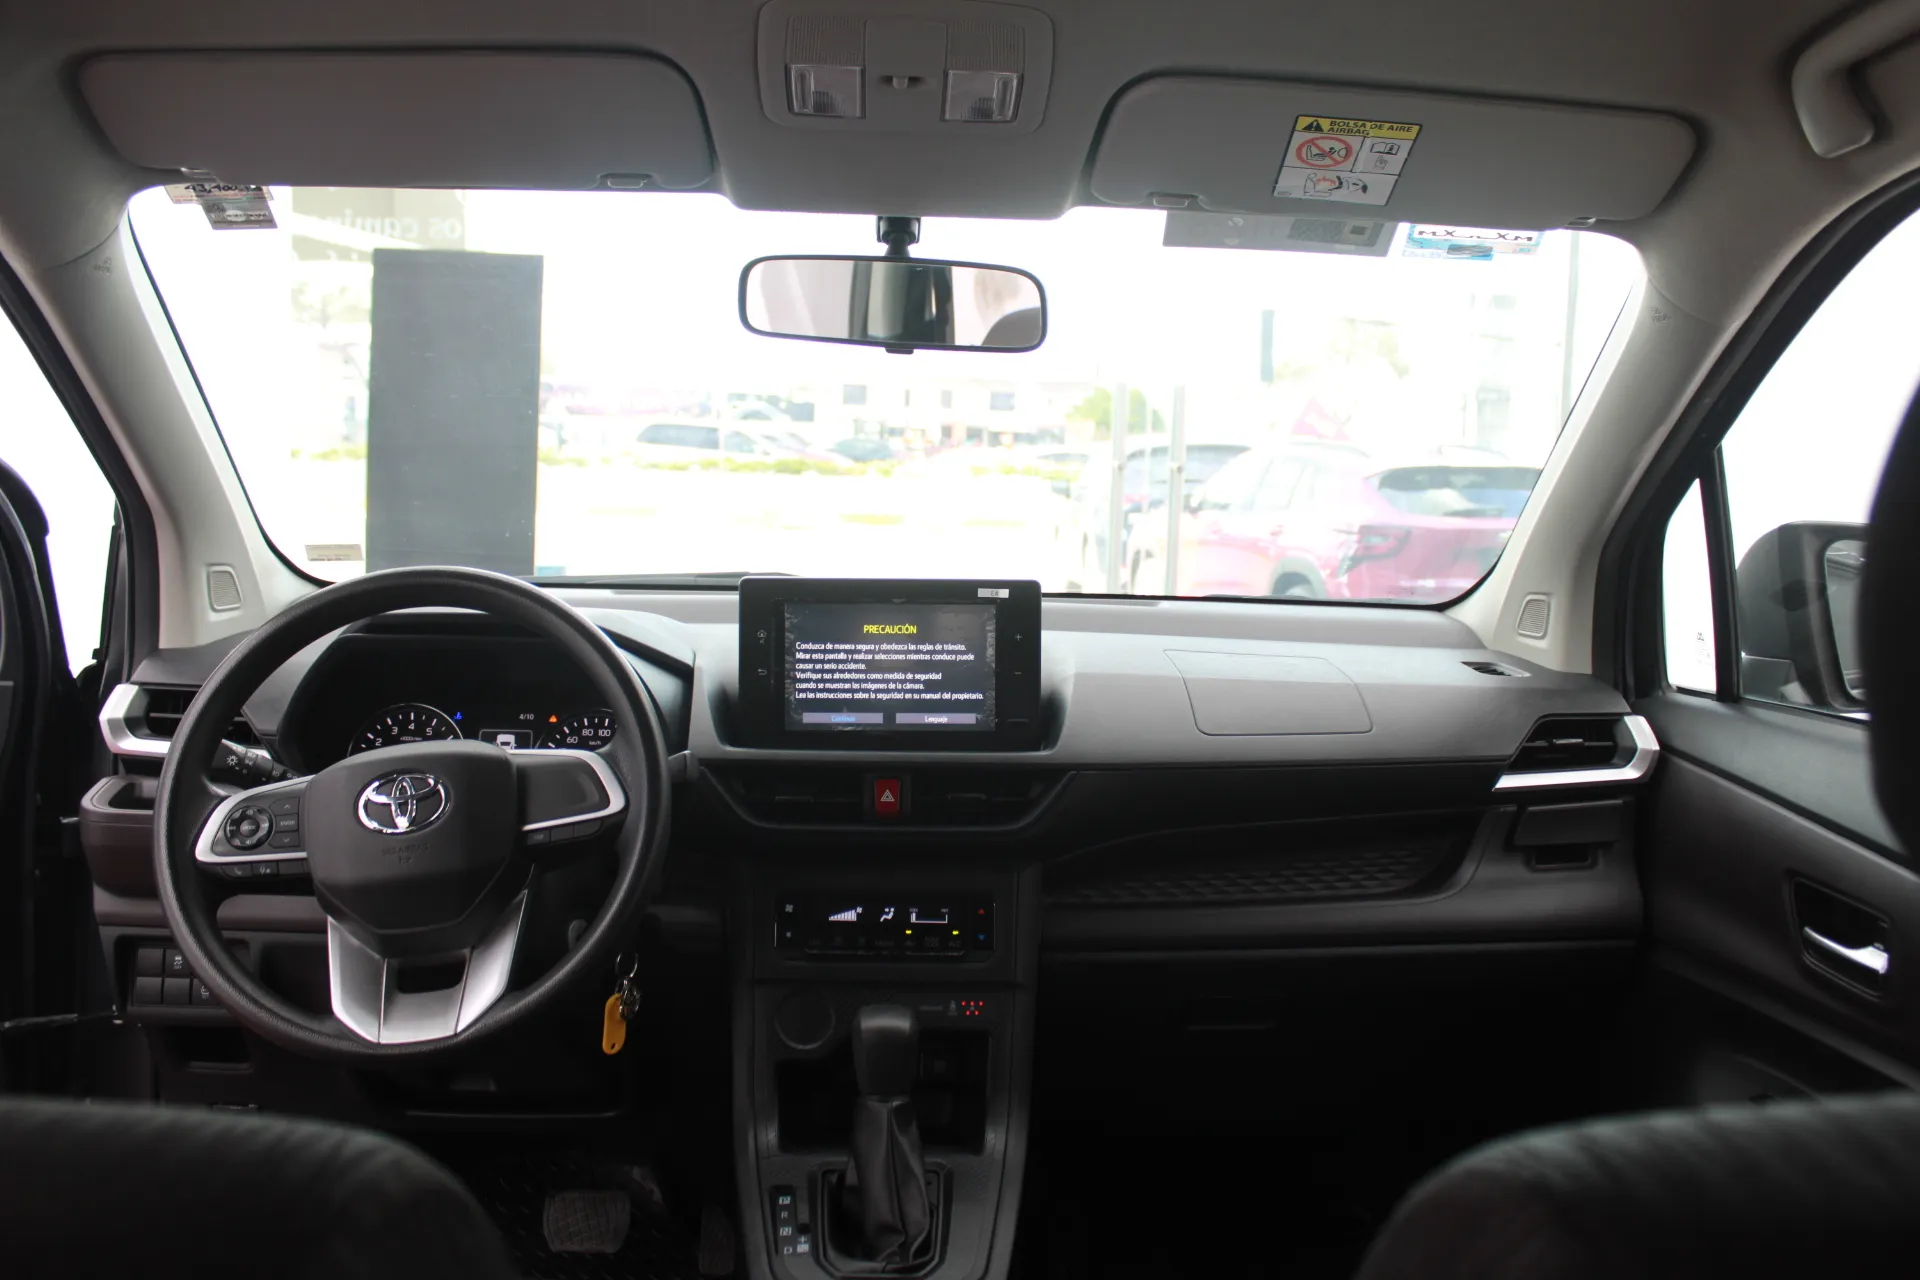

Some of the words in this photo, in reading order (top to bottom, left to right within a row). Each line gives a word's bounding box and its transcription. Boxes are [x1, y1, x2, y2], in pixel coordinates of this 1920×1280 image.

[1327, 126, 1370, 136] AIRBAG
[1329, 120, 1367, 129] BOLSA
[1369, 122, 1385, 131] DE
[1387, 124, 1413, 133] AIRE
[863, 623, 917, 634] PRECAUCIÓN
[795, 642, 825, 650] Conduzca
[825, 642, 833, 650] de
[880, 643, 908, 651] obedezca
[908, 643, 916, 651] las
[917, 643, 934, 652] reglas
[934, 643, 942, 651] de
[943, 643, 967, 651] tránsito.
[795, 652, 811, 660] Mirar
[824, 652, 847, 661] pantalla
[852, 652, 873, 660] realizar
[874, 652, 905, 660] selecciones
[931, 653, 956, 661] conduce
[956, 653, 975, 662] puede
[823, 662, 837, 670] serio
[837, 662, 867, 670] accidente.
[796, 672, 822, 680] Verifique
[884, 672, 905, 680] medida
[905, 672, 914, 680] de
[914, 672, 942, 681] seguridad
[860, 682, 887, 690] imágenes
[902, 682, 925, 690] cámara.
[795, 691, 806, 699] Lea
[806, 691, 815, 699] las
[815, 691, 852, 699] instrucciones
[853, 691, 869, 699] sobre
[870, 691, 875, 699] la
[876, 692, 904, 701] seguridad
[951, 692, 984, 700] propietario.
[924, 715, 948, 723] Lenguaje
[391, 726, 398, 735] 3
[408, 722, 415, 730] 4
[426, 727, 433, 736] 5
[581, 728, 594, 736] 80
[598, 729, 611, 737] 100
[375, 738, 382, 746] 2
[566, 736, 578, 744] 60
[781, 1211, 789, 1219] R
[783, 1246, 793, 1255] D
